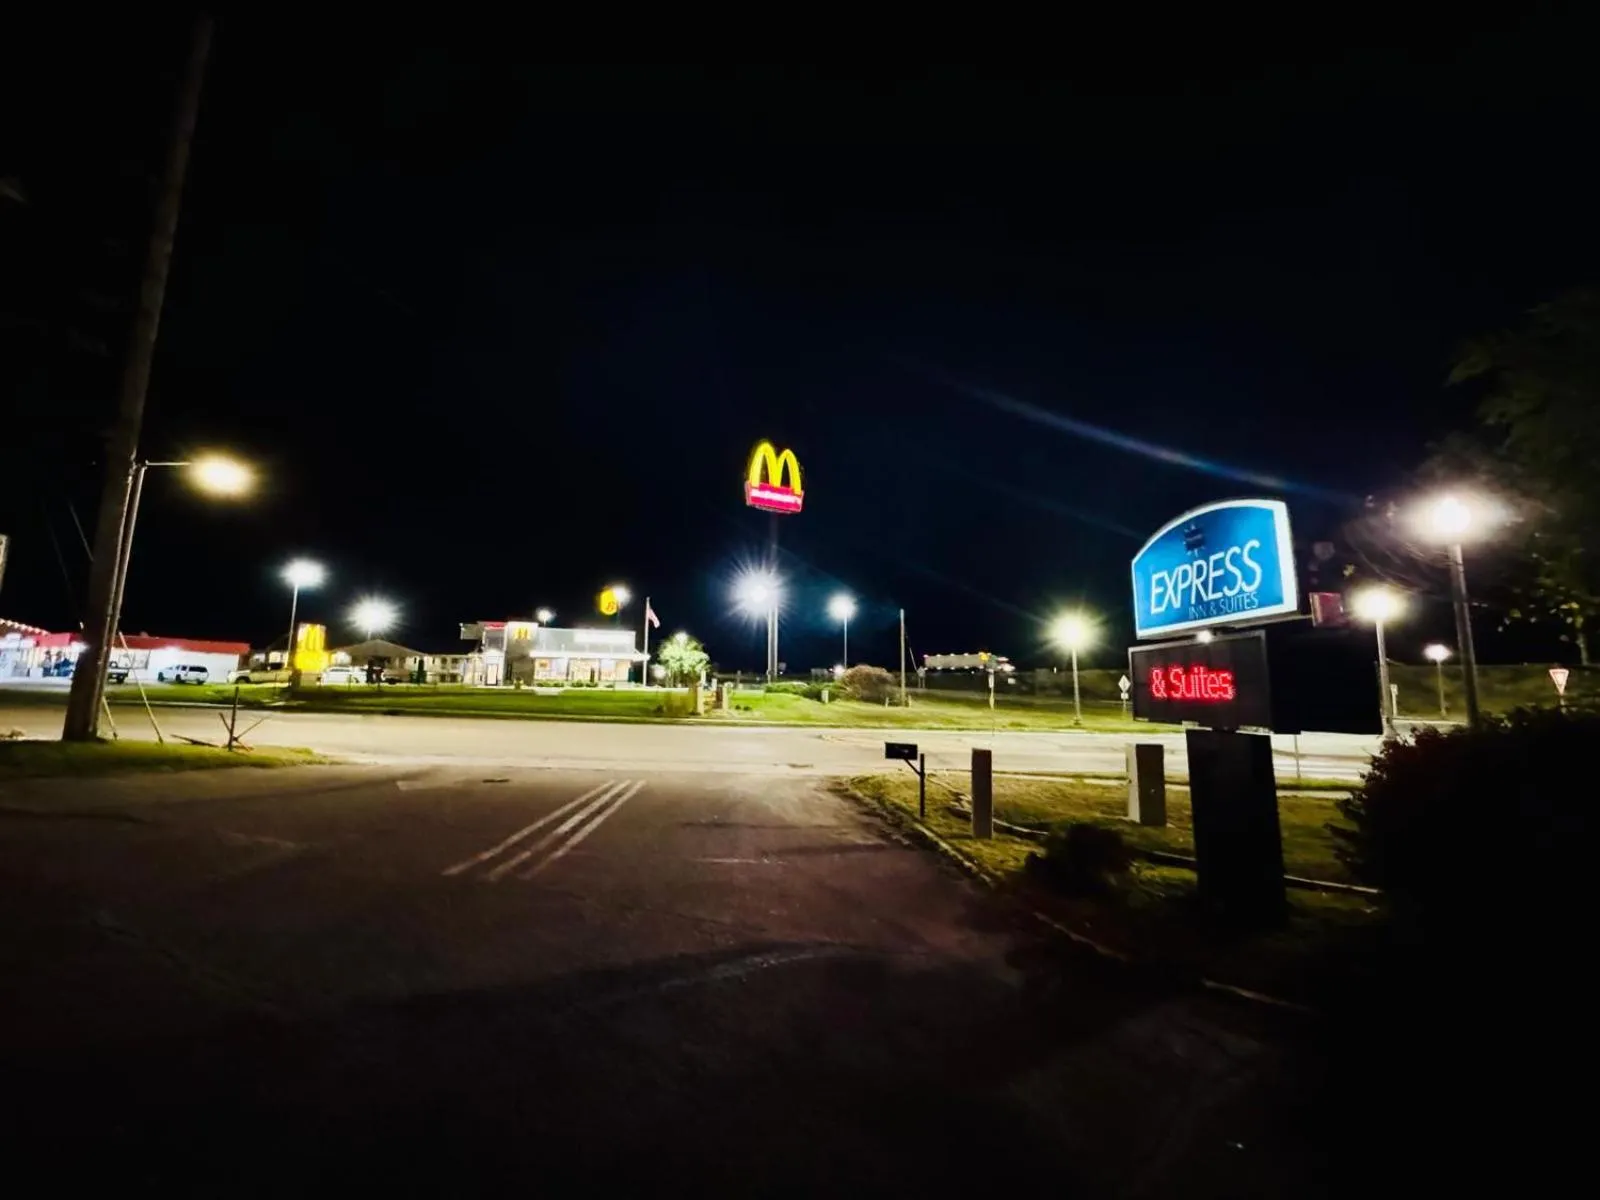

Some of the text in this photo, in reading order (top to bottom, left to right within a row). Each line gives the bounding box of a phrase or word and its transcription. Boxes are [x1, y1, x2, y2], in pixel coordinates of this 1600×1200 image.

[1151, 539, 1262, 616] EXPRESS
[1220, 591, 1259, 614] SUITES
[1151, 665, 1234, 700] & Suites
